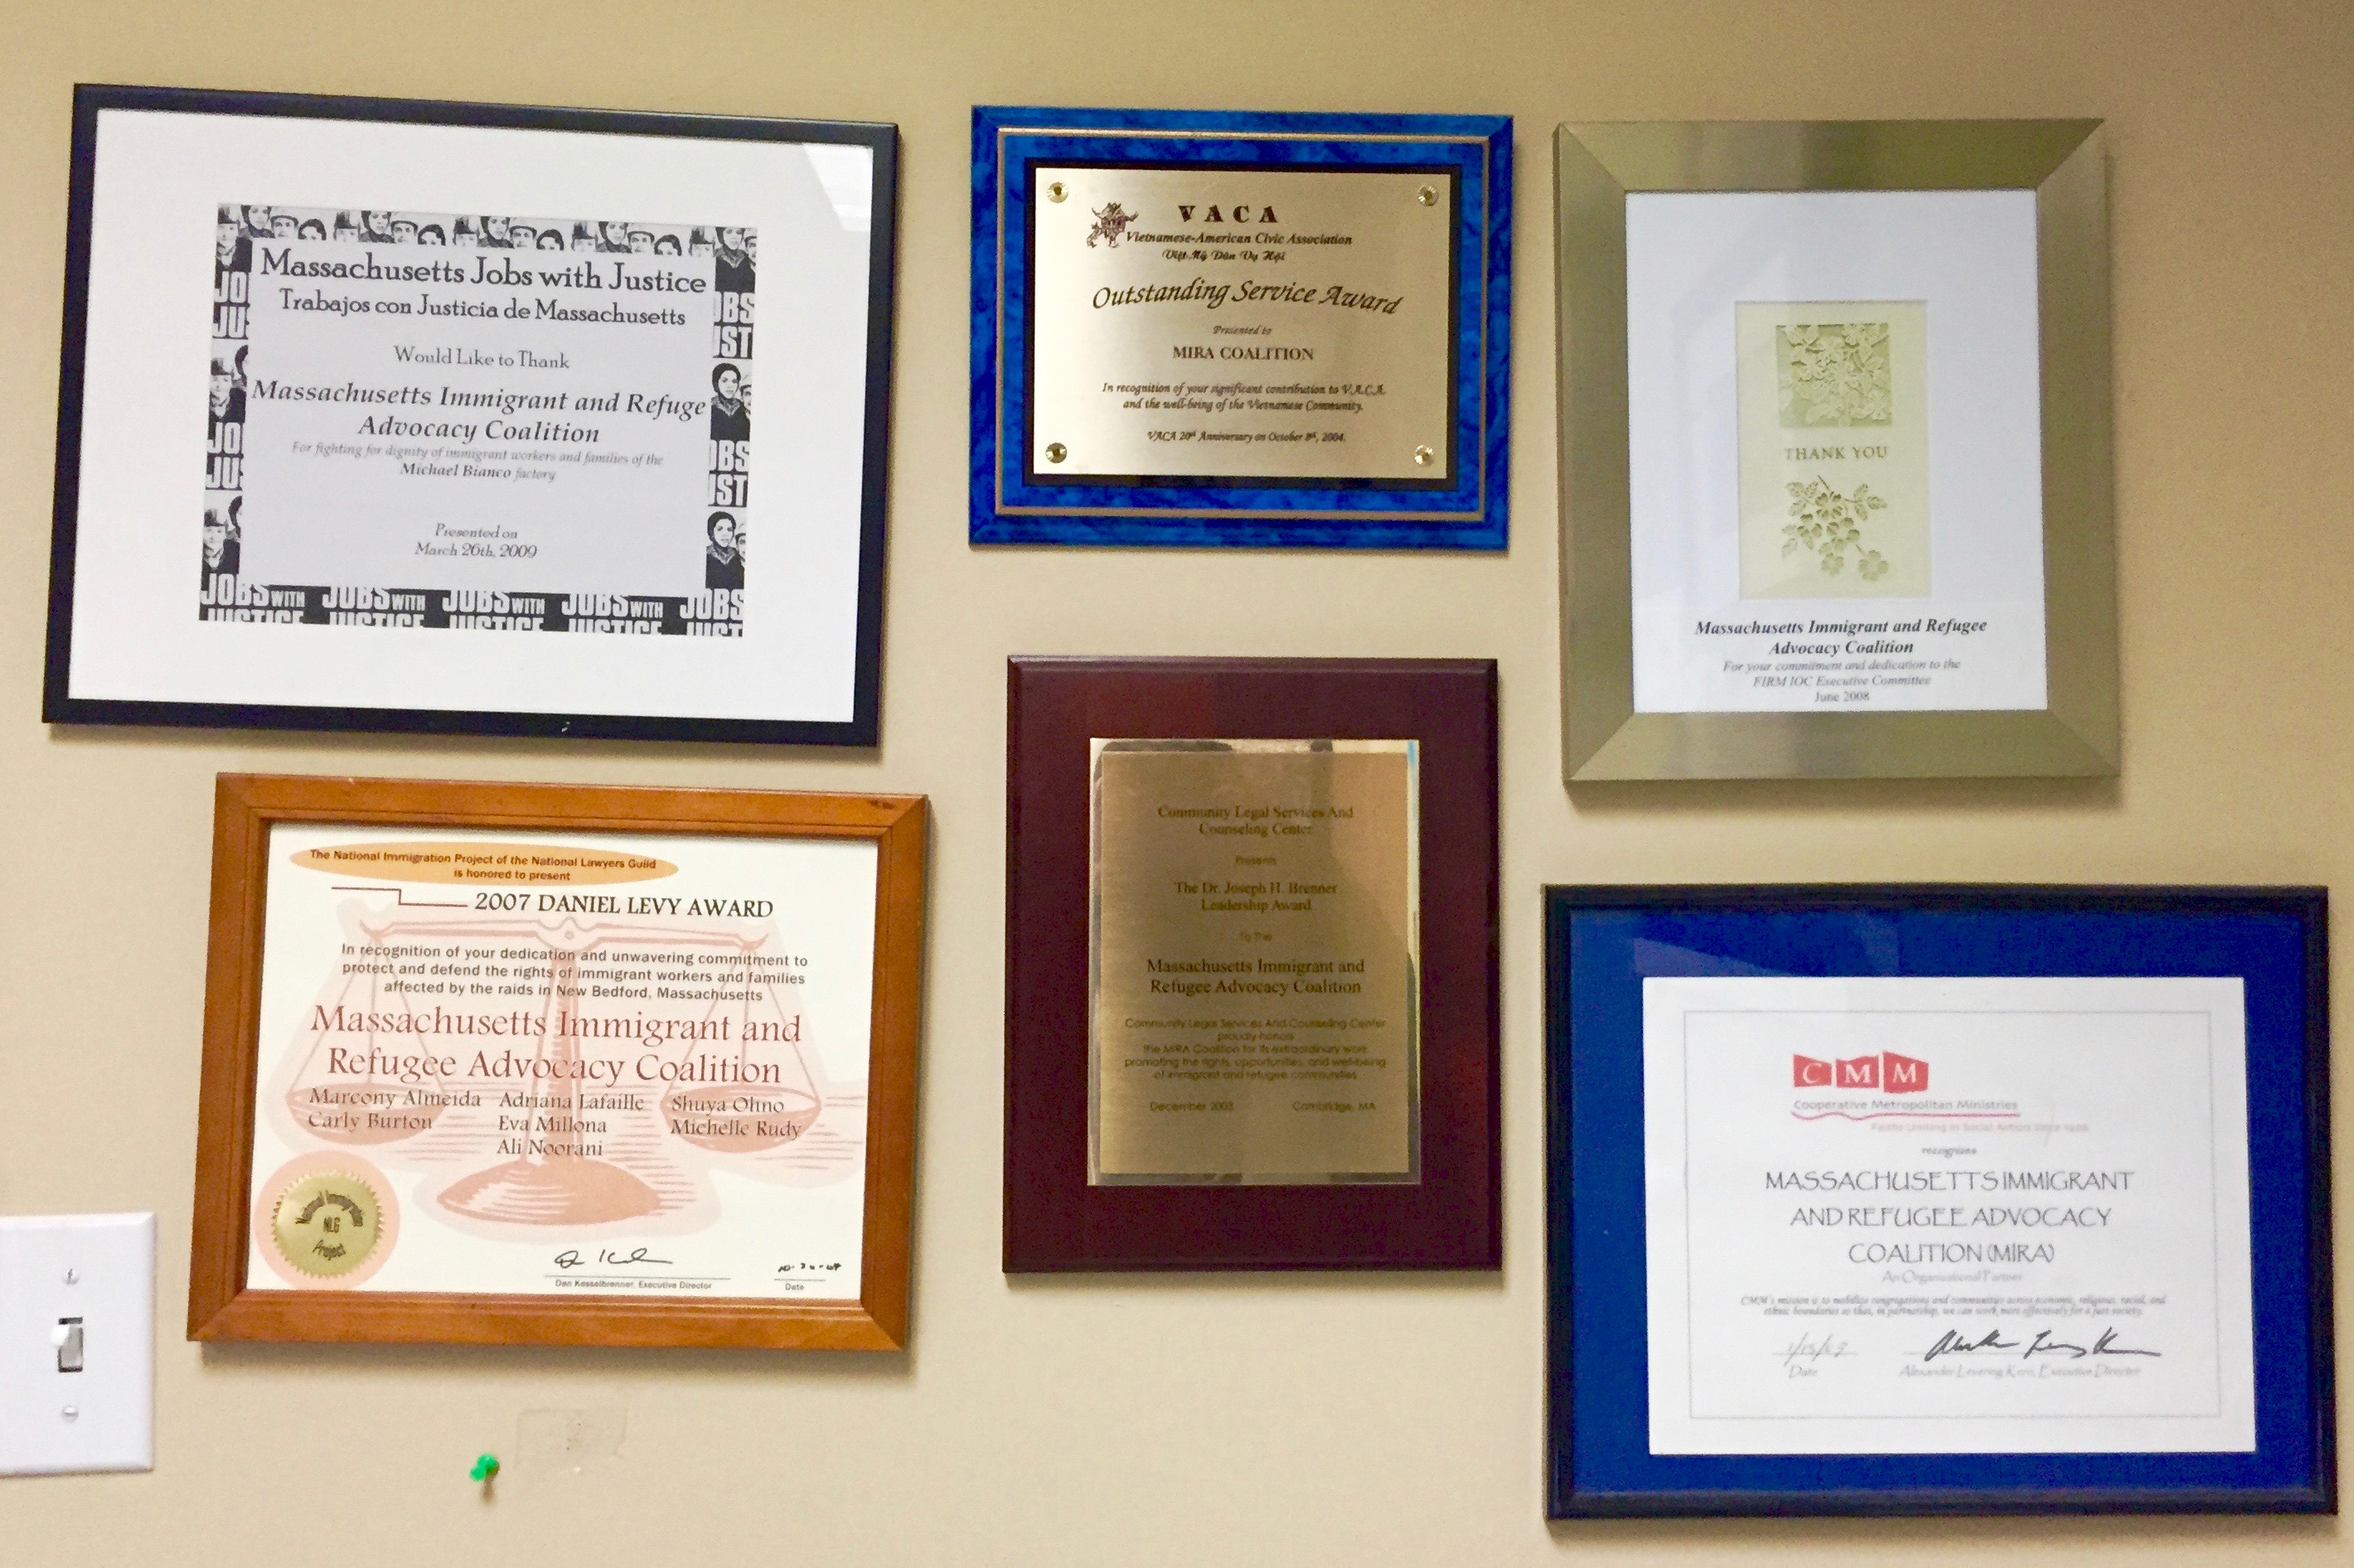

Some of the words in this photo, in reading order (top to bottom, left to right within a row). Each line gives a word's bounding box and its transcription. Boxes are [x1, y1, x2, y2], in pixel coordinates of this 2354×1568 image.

[1126, 230, 1252, 244] Vietnamese-American
[1254, 231, 1285, 244] Civic
[1286, 233, 1353, 245] Association
[260, 247, 465, 284] Massachusetts
[470, 255, 533, 287] Jobs
[538, 260, 603, 289] with
[608, 261, 707, 293] Justice
[1092, 276, 1232, 310] Outstanding
[1230, 279, 1318, 303] Service
[1317, 285, 1404, 315] Award
[279, 287, 371, 317] Trabajos
[375, 301, 412, 315] con
[416, 293, 500, 318] Justicia
[503, 297, 531, 320] de
[535, 298, 686, 326] Massachusetts
[393, 345, 453, 365] Would
[456, 347, 495, 366] Like
[498, 353, 515, 367] to
[517, 349, 570, 369] Thank
[1173, 346, 1215, 360] MIRA
[1219, 346, 1314, 361] COALITION
[1102, 382, 1114, 393] In
[1116, 383, 1171, 397] recognition
[1172, 381, 1186, 397] of
[1184, 385, 1209, 397] your
[1265, 382, 1326, 395] contribution
[1328, 385, 1339, 395] to
[251, 380, 432, 405] Massachusetts
[440, 386, 569, 415] Immigrant
[574, 392, 620, 412] and
[626, 393, 706, 422] Refuge
[1122, 397, 1145, 409] and
[1145, 396, 1161, 409] the
[1214, 397, 1229, 414] of
[357, 415, 477, 445] Advocacy
[485, 419, 599, 443] Coalition
[1146, 430, 1177, 443] VACA
[291, 440, 313, 453] For
[314, 441, 363, 459] fighting
[385, 443, 429, 461] dignity
[510, 449, 557, 462] workers
[559, 450, 582, 463] and
[582, 451, 629, 467] families
[1785, 446, 1846, 462] THANK
[1851, 445, 1888, 460] YOU
[402, 462, 459, 477] Michael
[462, 464, 512, 478] Bianco
[512, 467, 557, 484] factory
[434, 522, 501, 539] Presented
[501, 530, 518, 540] on
[414, 541, 458, 557] March
[499, 544, 538, 559] 2009
[1697, 620, 1804, 635] Massachusetts
[1808, 619, 1889, 636] Immigrant
[1892, 618, 1922, 633] and
[1925, 617, 1988, 636] Refugee
[1771, 641, 1841, 658] Advocacy
[1844, 640, 1914, 655] Coalition
[1867, 658, 1927, 670] dedication
[1815, 675, 1869, 687] Executive
[1157, 804, 1232, 821] Community
[1234, 805, 1270, 822] Legal
[1272, 805, 1326, 820] Services
[1326, 806, 1354, 820] And
[1198, 822, 1269, 839] Counseling
[1271, 821, 1314, 836] Center
[309, 849, 331, 860] The
[333, 849, 380, 861] National
[383, 851, 452, 864] Immigration
[454, 853, 494, 866] Project
[496, 854, 509, 865] of
[510, 855, 529, 866] the
[530, 855, 578, 867] National
[580, 858, 626, 869] Lawyers
[627, 858, 657, 869] Guild
[453, 869, 464, 878] is
[465, 868, 512, 879] honored
[514, 870, 526, 880] to
[528, 872, 571, 882] present
[474, 892, 531, 912] 2007
[538, 894, 621, 914] DANIEL
[627, 897, 682, 916] LEVY
[686, 898, 773, 918] AWARD
[1200, 898, 1270, 915] Leadership
[1270, 898, 1312, 912] Award
[341, 943, 355, 956] In
[360, 945, 441, 960] recognition
[445, 945, 460, 958] of
[464, 949, 496, 961] your
[500, 947, 576, 962] dedication
[579, 950, 607, 962] and
[612, 951, 695, 967] unwavering
[697, 954, 789, 968] commitment
[794, 956, 808, 967] to
[342, 962, 395, 975] protect
[398, 963, 426, 975] and
[429, 963, 481, 977] defend
[485, 965, 509, 977] the
[513, 965, 555, 981] rights
[558, 966, 573, 980] of
[577, 969, 652, 983] immigrant
[656, 970, 713, 983] workers
[717, 971, 743, 985] and
[747, 970, 806, 985] families
[1146, 958, 1253, 974] Massachusetts
[1257, 957, 1334, 977] Immigrant
[1338, 958, 1365, 974] and
[384, 980, 444, 994] affected
[448, 981, 465, 997] by
[470, 982, 493, 995] the
[497, 984, 534, 996] raids
[538, 984, 552, 997] in
[556, 984, 588, 998] New
[591, 985, 652, 999] Bedford,
[656, 986, 763, 1004] Massachusetts
[1150, 978, 1212, 998] Refugee
[1214, 978, 1290, 998] Advocacy
[1292, 978, 1362, 995] Coalition
[310, 1004, 547, 1037] Massachusetts
[559, 1010, 729, 1048] Immigrant
[741, 1014, 801, 1043] and
[327, 1047, 457, 1084] Refugee
[467, 1049, 626, 1089] Advocacy
[636, 1053, 781, 1084] Coalition
[308, 1087, 397, 1110] Marcony
[402, 1089, 482, 1107] Almeida
[499, 1091, 572, 1111] Adriana
[578, 1093, 645, 1112] Lafaille
[671, 1094, 726, 1117] Shuya
[732, 1096, 785, 1114] Ohno
[1793, 1100, 1868, 1112] Cooperative
[1871, 1099, 1954, 1111] Metropolitan
[1955, 1100, 2018, 1111] Ministries
[307, 1111, 360, 1130] Carly
[367, 1112, 432, 1130] Burton
[498, 1115, 531, 1134] Eva
[535, 1116, 607, 1135] Millona
[670, 1118, 749, 1136] Michelle
[756, 1120, 802, 1141] Rudy
[496, 1137, 522, 1155] Ali
[528, 1139, 603, 1158] Noorani
[1765, 1170, 1999, 1192] MASSACHUSETTS
[2002, 1170, 2134, 1191] IMMIGRANT
[1790, 1207, 1844, 1227] AND
[1848, 1207, 1968, 1228] REFUGEE
[1971, 1207, 2112, 1228] ADVOCACY
[1848, 1242, 1983, 1264] COALITION
[637, 1280, 678, 1290] Executive
[679, 1280, 712, 1290] Director
[784, 1282, 805, 1291] Date
